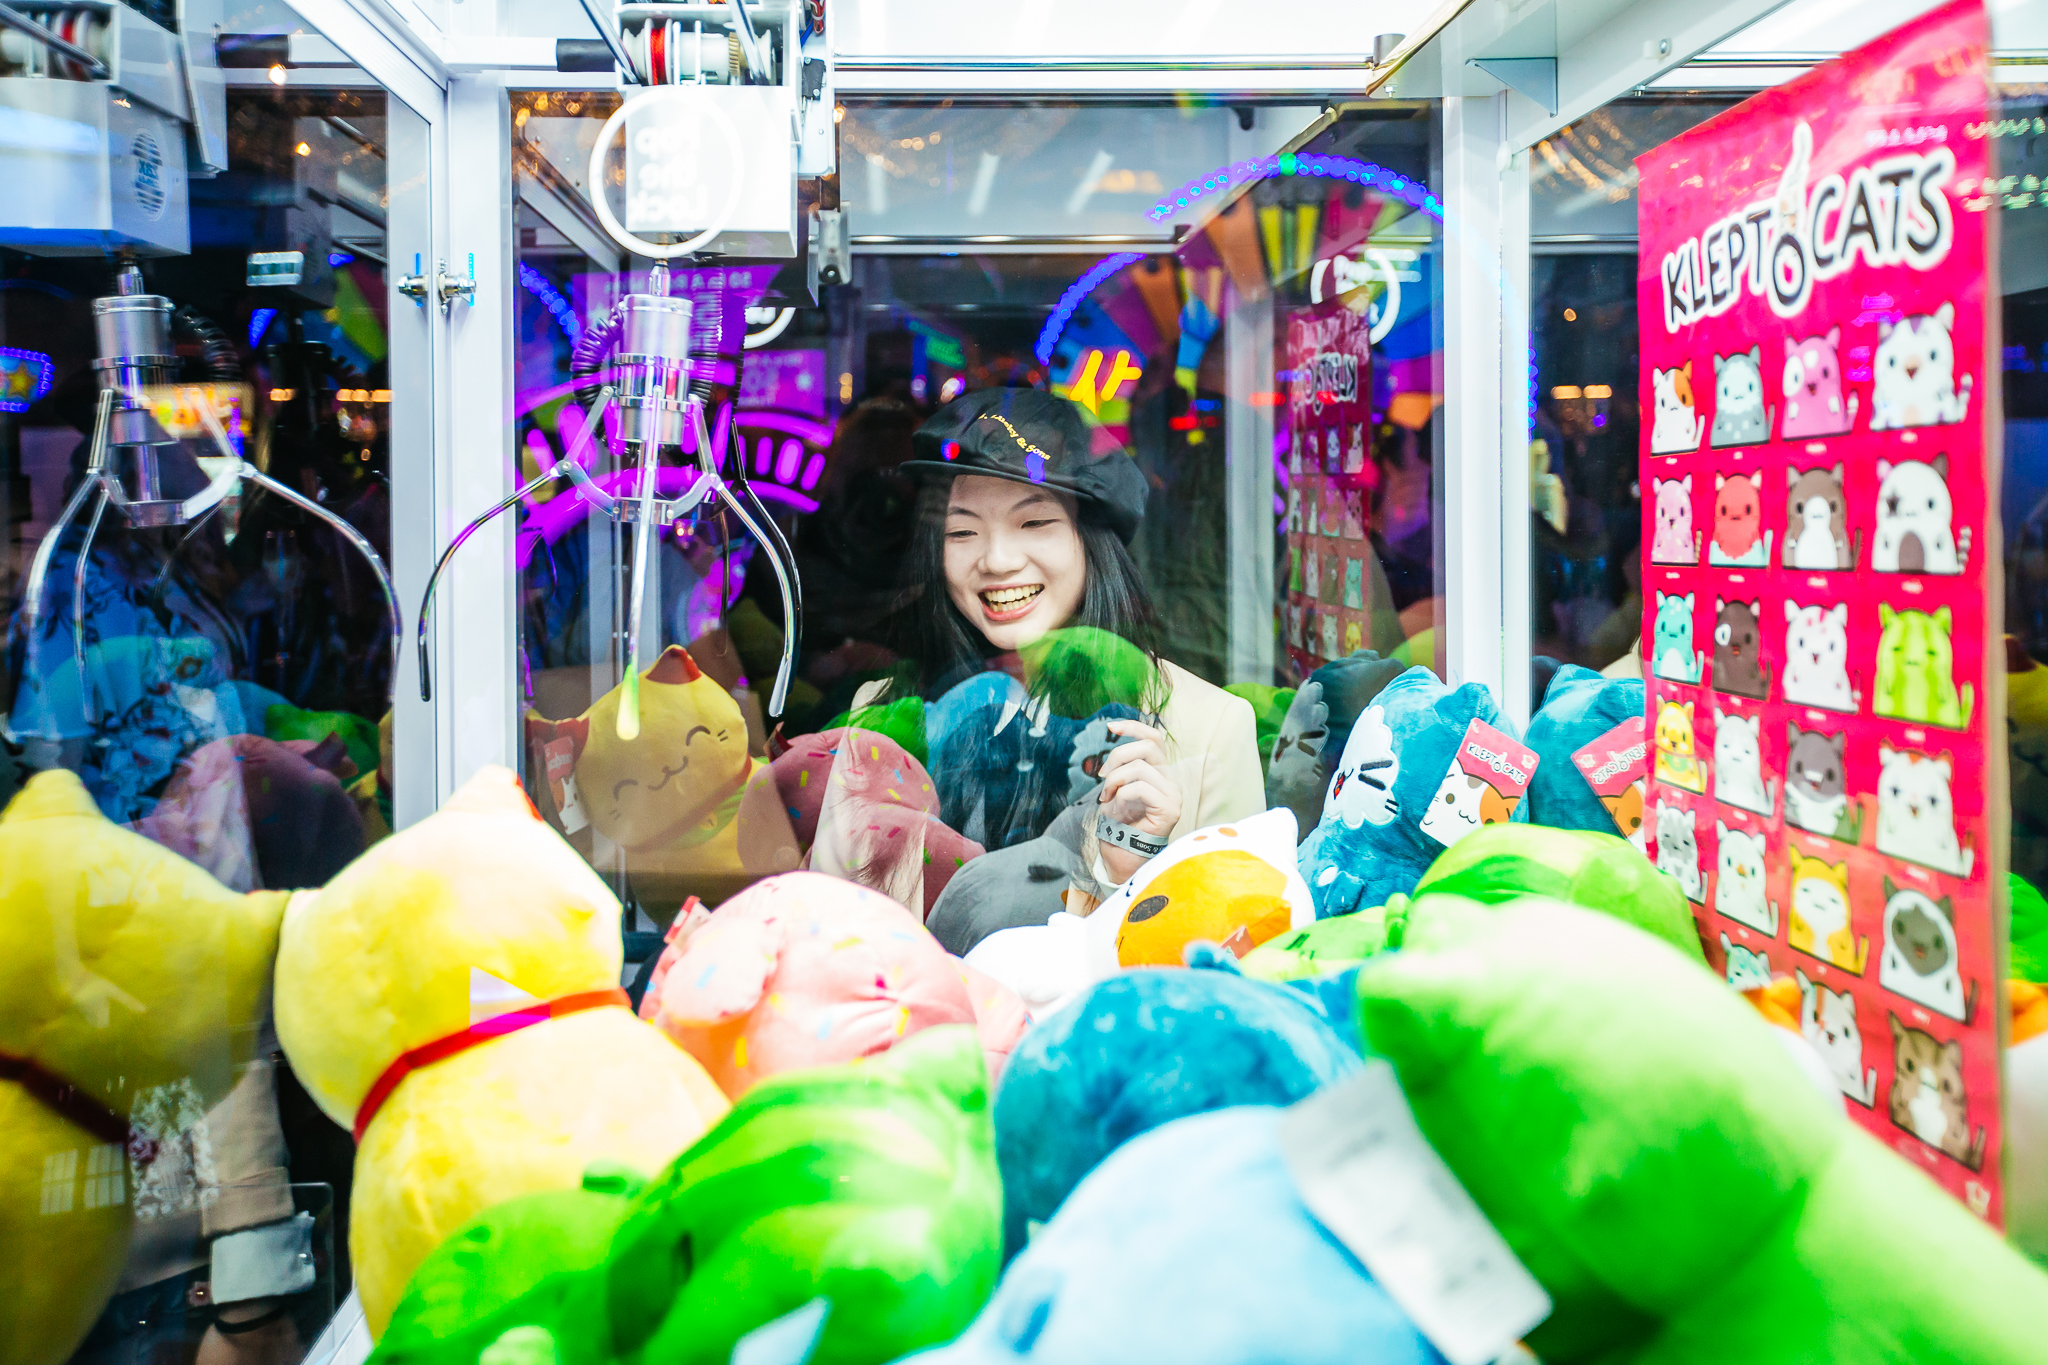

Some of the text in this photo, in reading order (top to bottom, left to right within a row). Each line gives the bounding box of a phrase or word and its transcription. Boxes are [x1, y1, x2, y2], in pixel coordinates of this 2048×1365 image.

[1662, 148, 1956, 333] KLEPTOCATS
[990, 414, 1019, 438] Lucky
[1016, 437, 1027, 449] &
[1025, 444, 1051, 461] Sons
[1467, 743, 1527, 785] KLEPTOCATS
